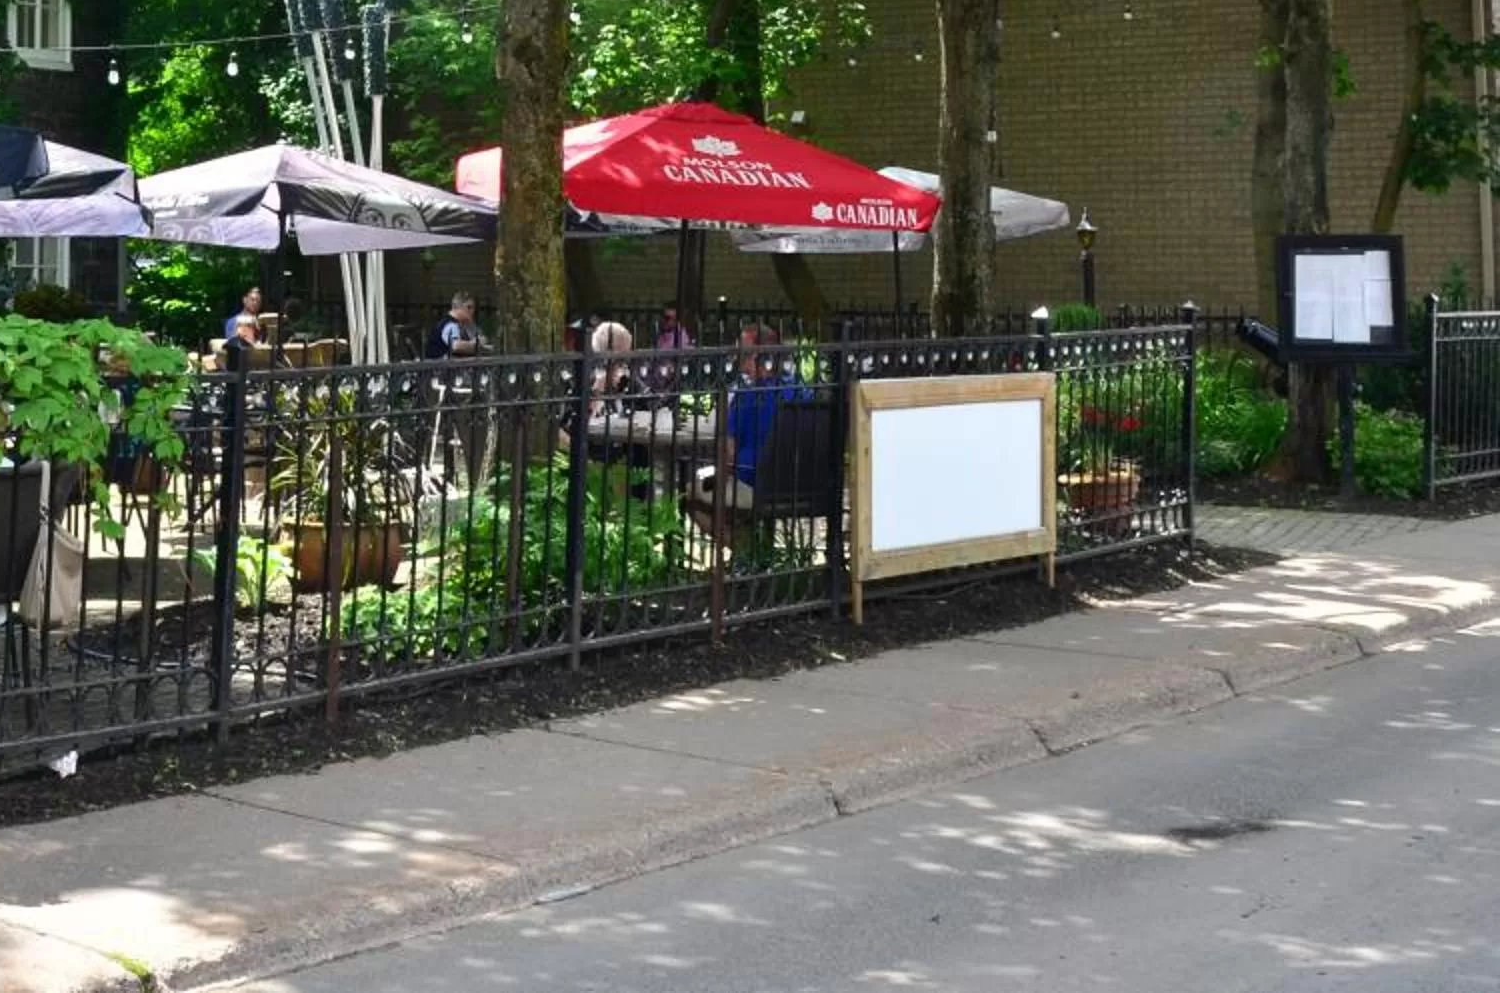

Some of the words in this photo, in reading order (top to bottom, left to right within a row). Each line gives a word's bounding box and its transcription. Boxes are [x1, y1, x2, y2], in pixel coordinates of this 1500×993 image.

[683, 157, 773, 171] MOLSON
[664, 164, 812, 190] CANADIAN
[835, 203, 917, 227] CANADIAN
